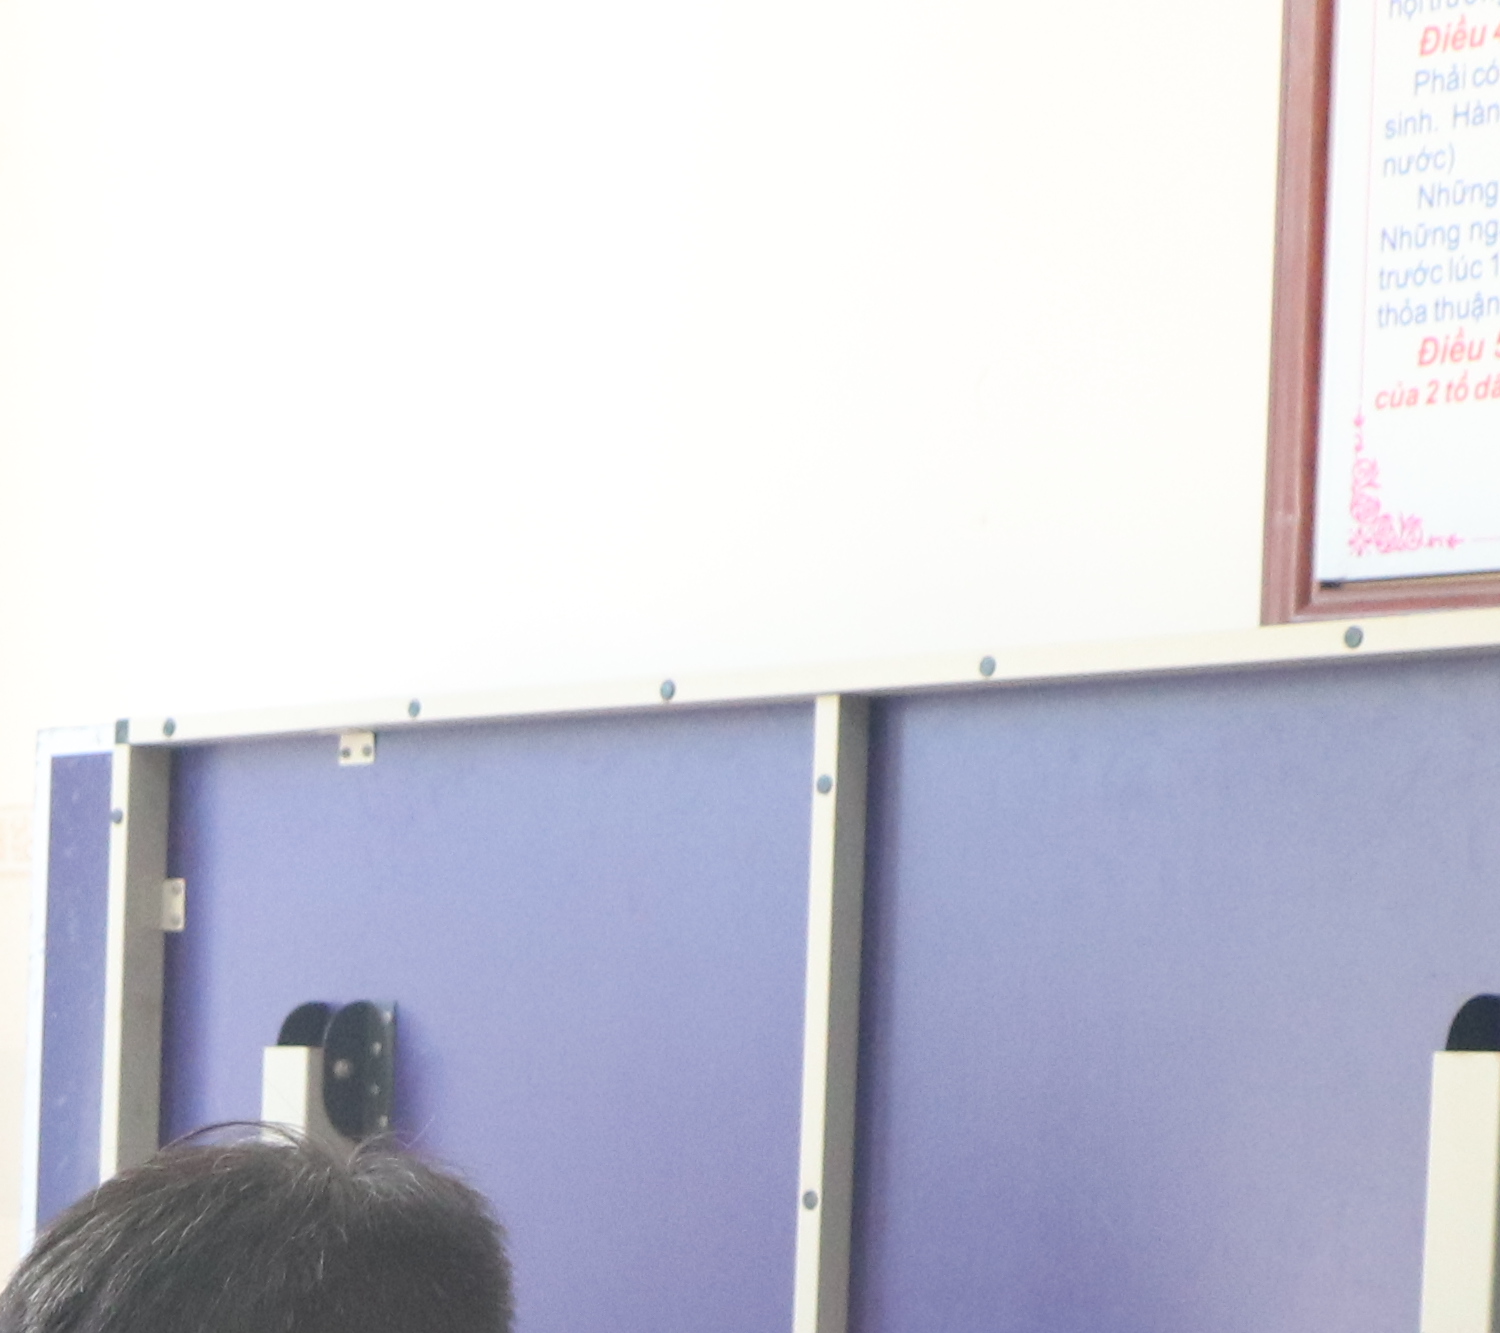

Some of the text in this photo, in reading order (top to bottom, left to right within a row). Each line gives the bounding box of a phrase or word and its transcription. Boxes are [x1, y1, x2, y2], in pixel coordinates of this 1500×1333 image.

[1385, 110, 1440, 139] sinh.
[1417, 179, 1498, 208] Những
[1380, 223, 1460, 251] Những
[1416, 327, 1484, 367] Điều
[1374, 382, 1419, 410] của
[1424, 378, 1440, 406] 2
